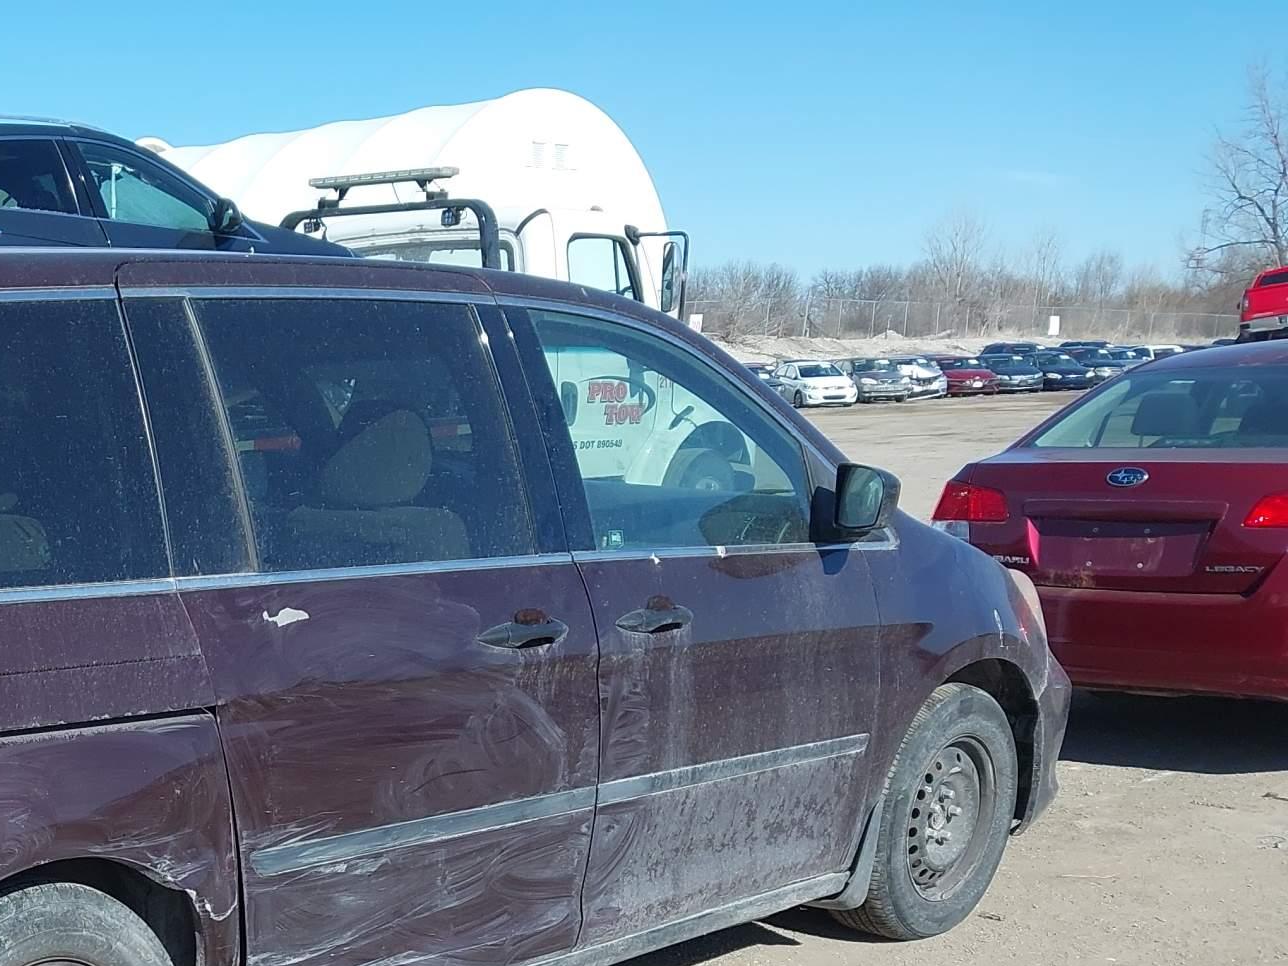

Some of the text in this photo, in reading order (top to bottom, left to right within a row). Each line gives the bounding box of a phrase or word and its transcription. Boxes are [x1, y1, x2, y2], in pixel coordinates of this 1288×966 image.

[587, 381, 628, 404] PRO
[604, 403, 646, 426] TOW
[579, 440, 596, 450] DOT
[1205, 565, 1265, 573] LEGACY
